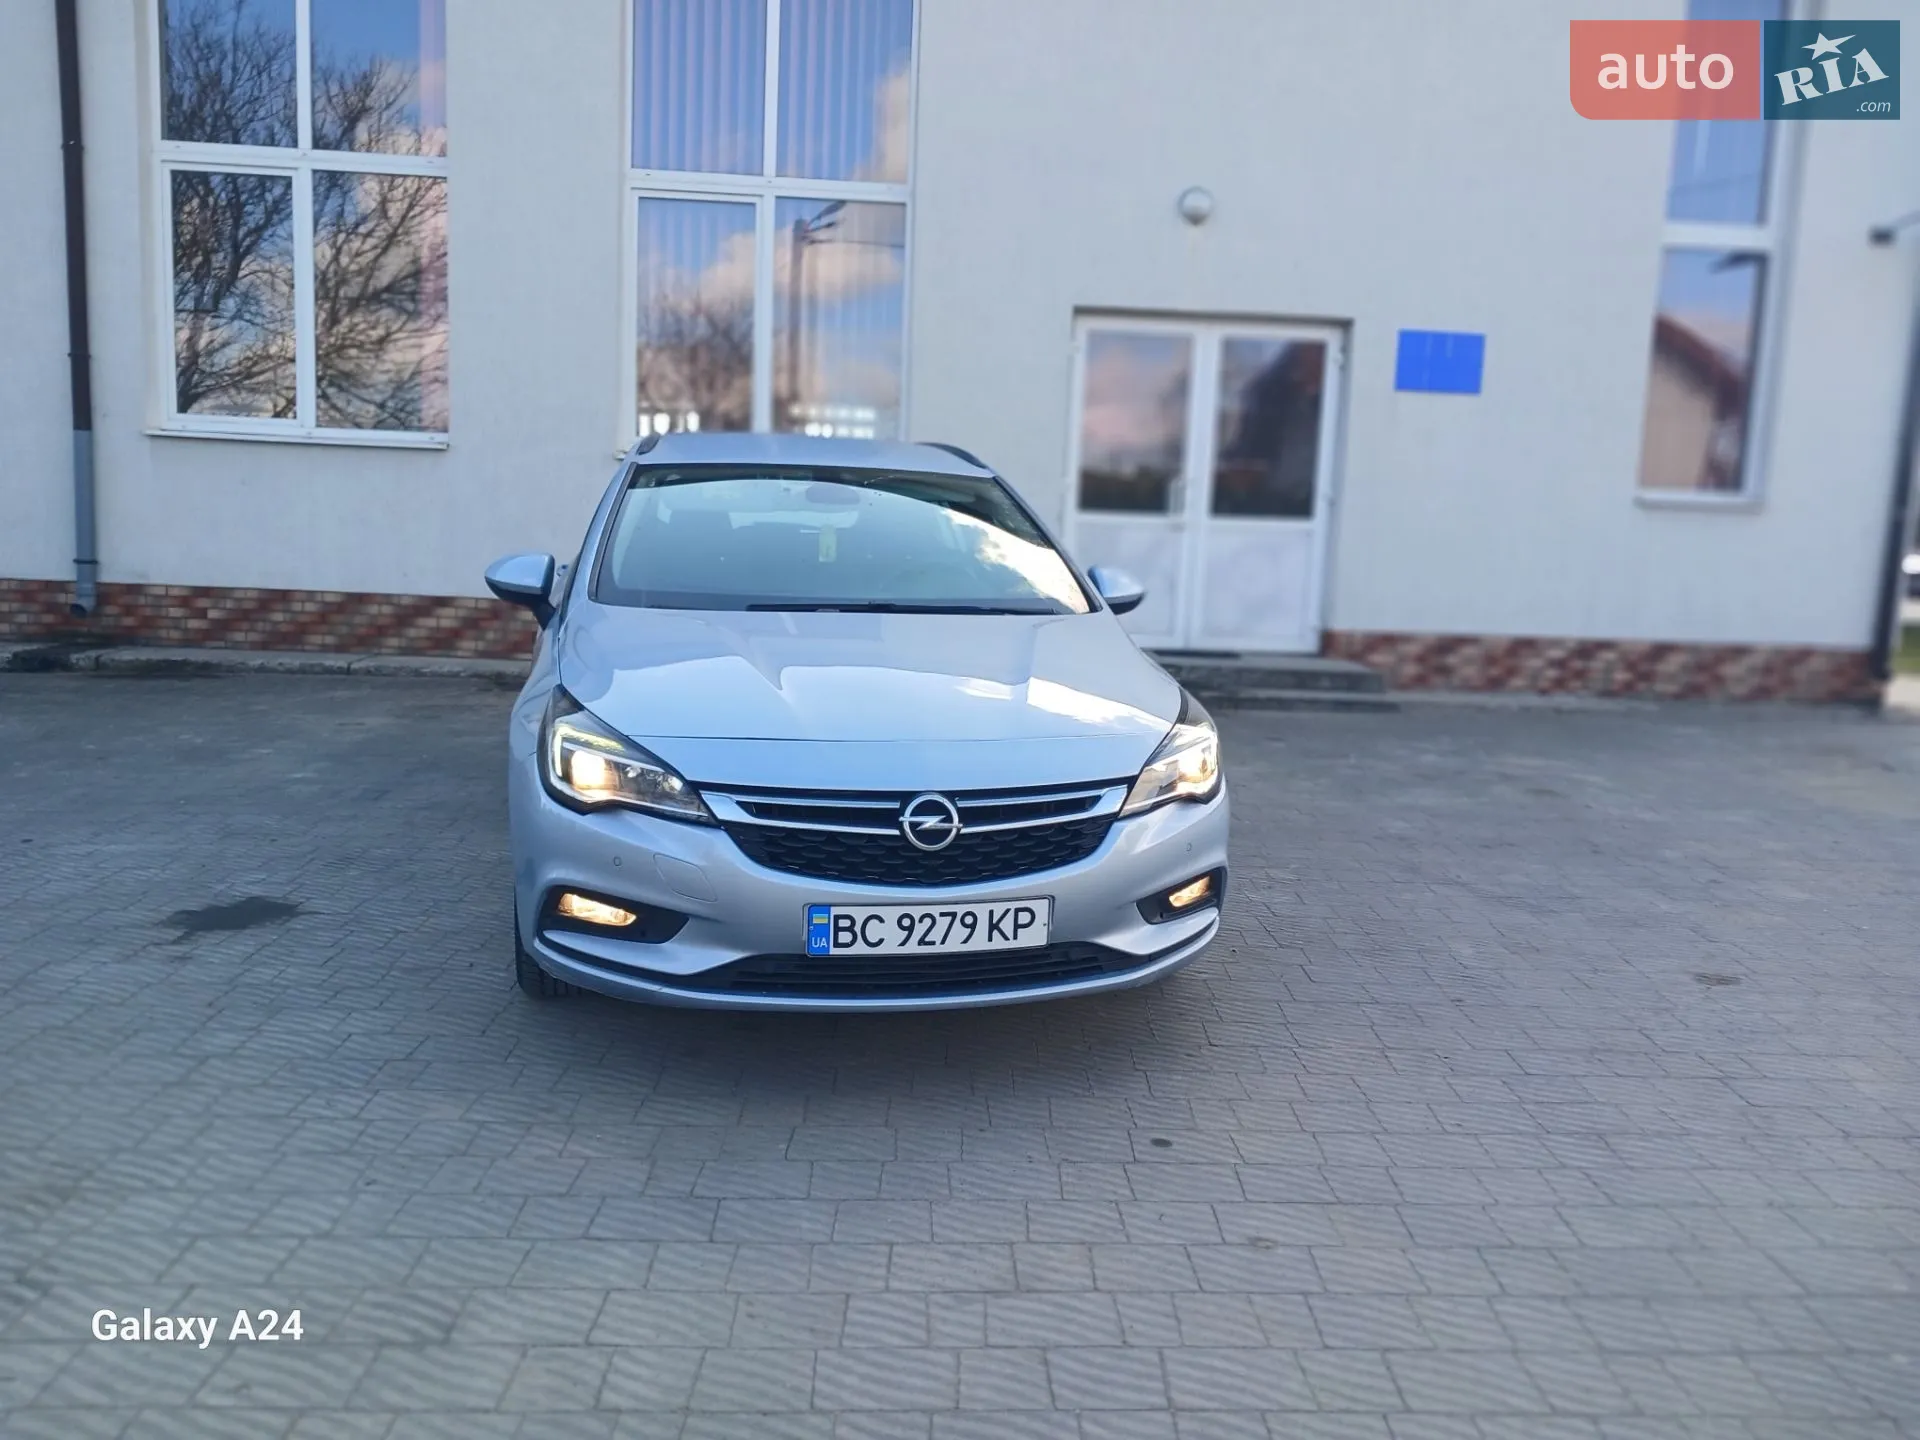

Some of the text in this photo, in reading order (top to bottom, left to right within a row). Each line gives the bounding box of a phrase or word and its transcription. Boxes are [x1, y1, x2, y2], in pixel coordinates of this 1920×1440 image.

[832, 906, 1036, 948] BC 9279 KP
[812, 937, 828, 948] UA
